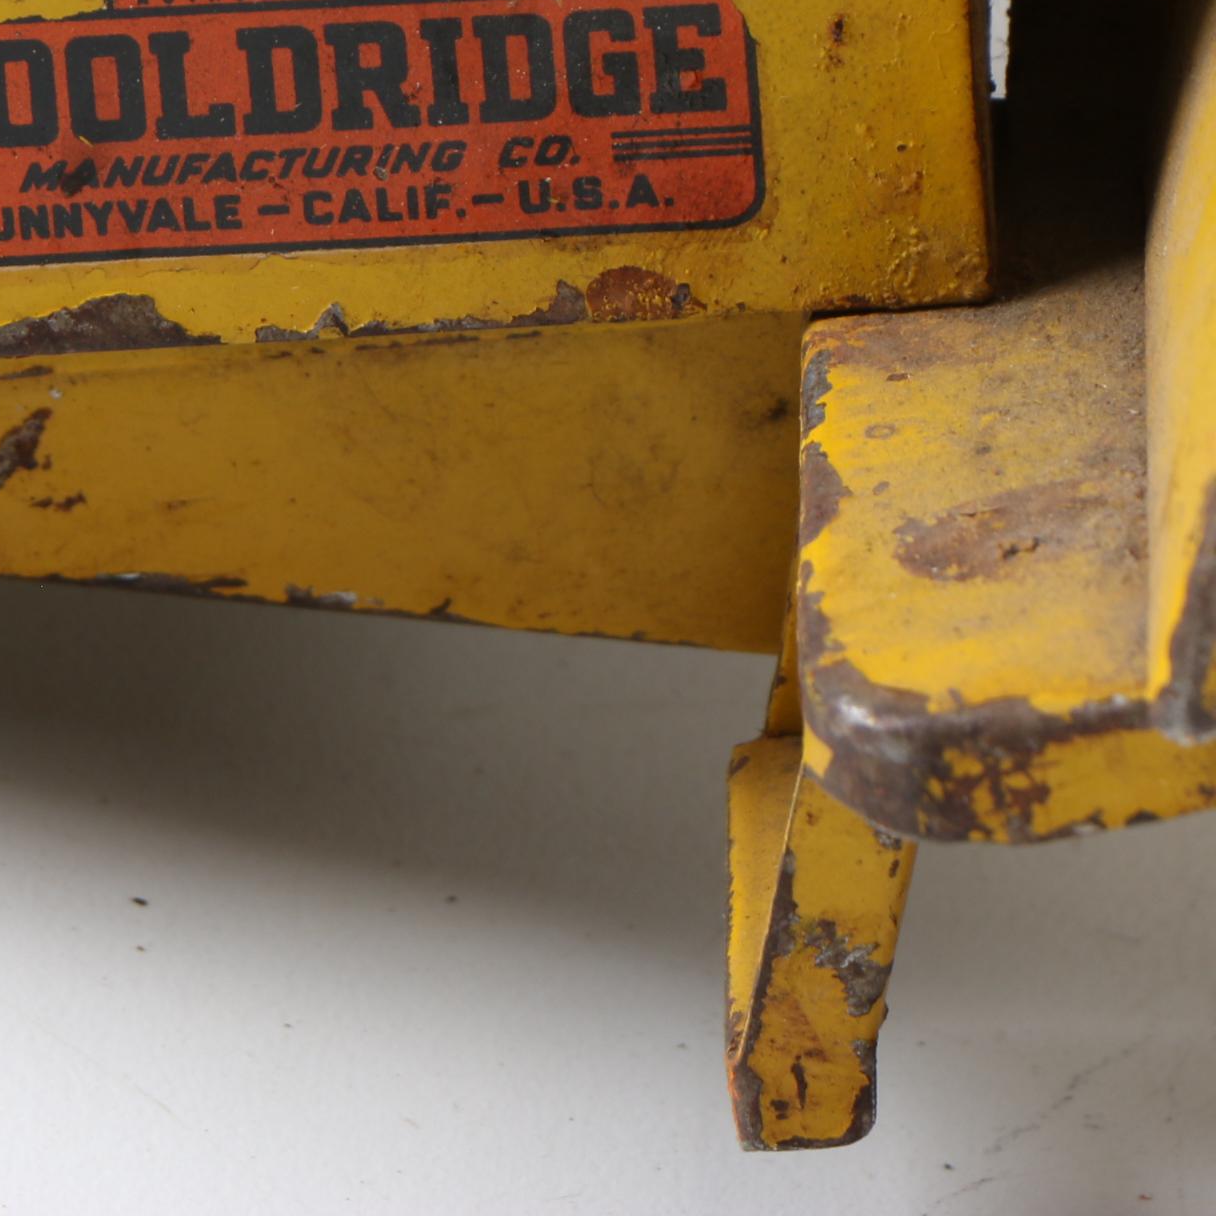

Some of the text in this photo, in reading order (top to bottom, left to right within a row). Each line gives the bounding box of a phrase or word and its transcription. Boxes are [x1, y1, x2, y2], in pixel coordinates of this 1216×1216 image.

[19, 136, 581, 193] MANUFACTURING CO.
[303, 189, 466, 223] CALIF.
[520, 174, 674, 211] U.S.A.
